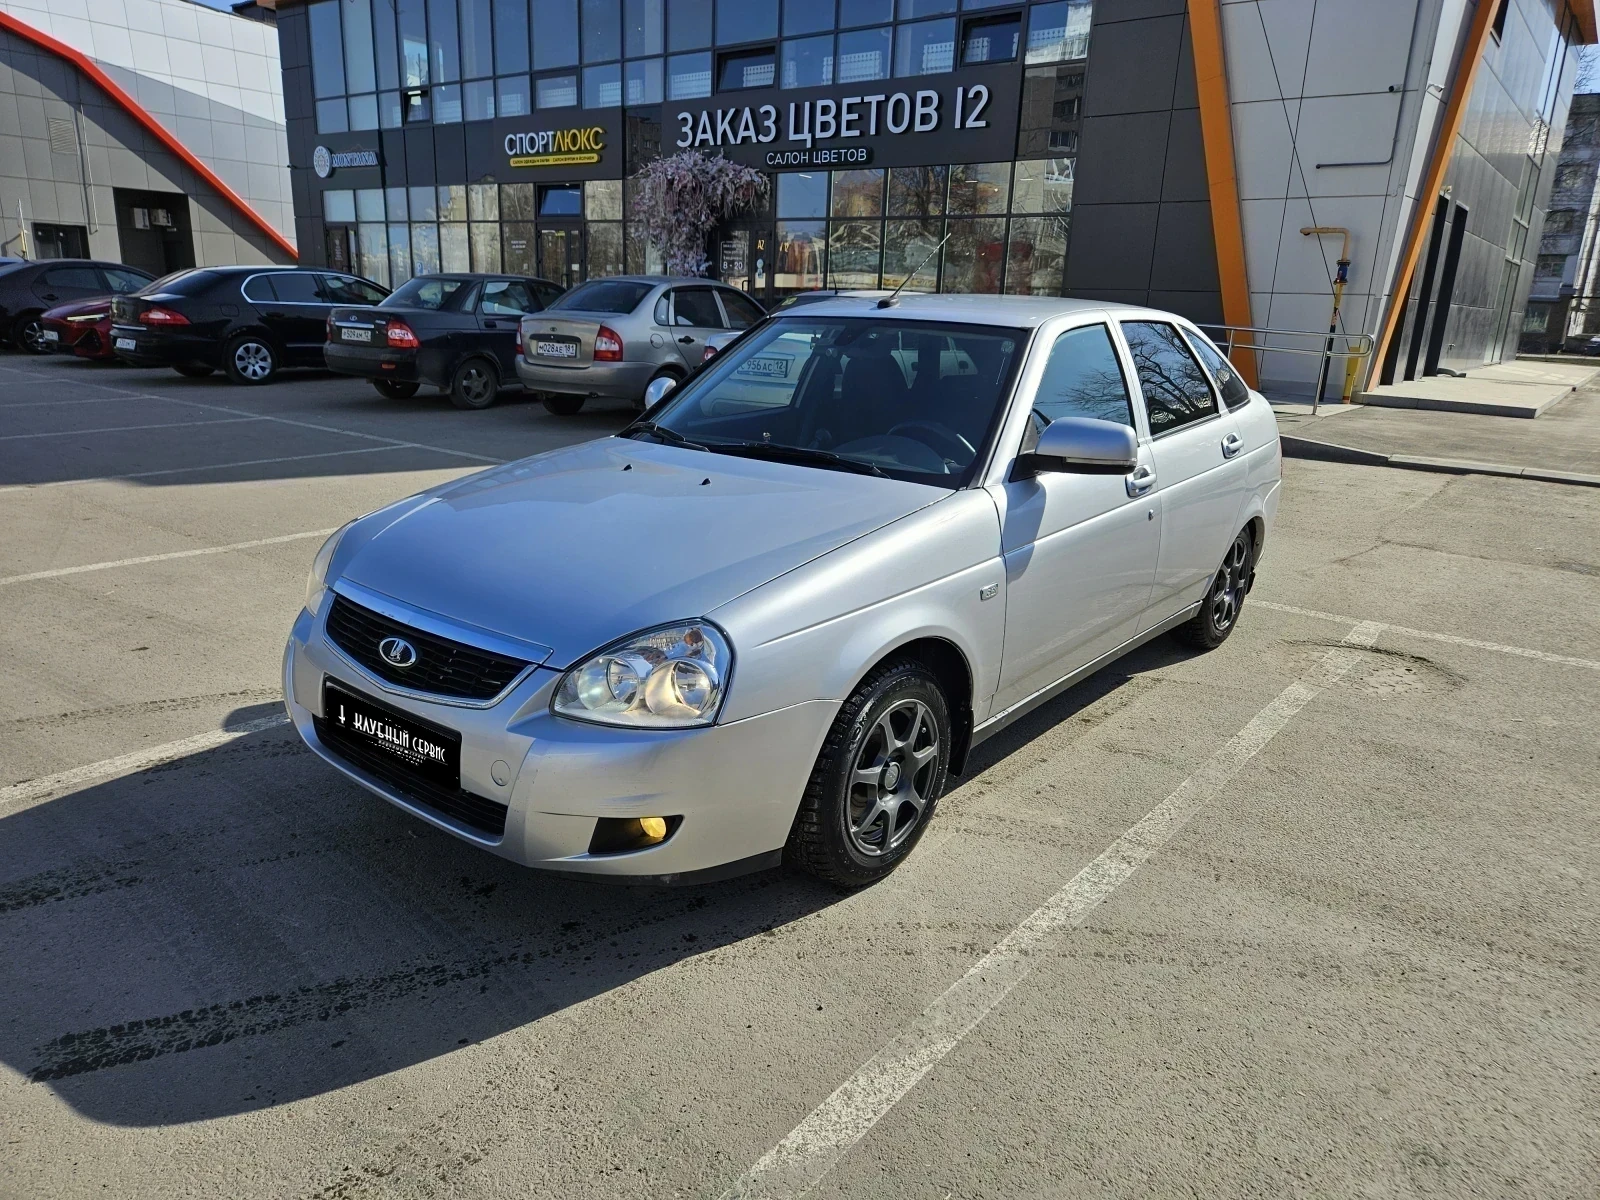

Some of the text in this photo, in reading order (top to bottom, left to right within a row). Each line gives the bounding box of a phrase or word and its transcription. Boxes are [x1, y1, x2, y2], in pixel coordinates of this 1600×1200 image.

[676, 84, 989, 148] ЗАКАЗ ЦВЕТОВ 12
[504, 126, 603, 155] СПОРТЛЮКС
[766, 148, 867, 166] САЛОН ЦВЕТОВ
